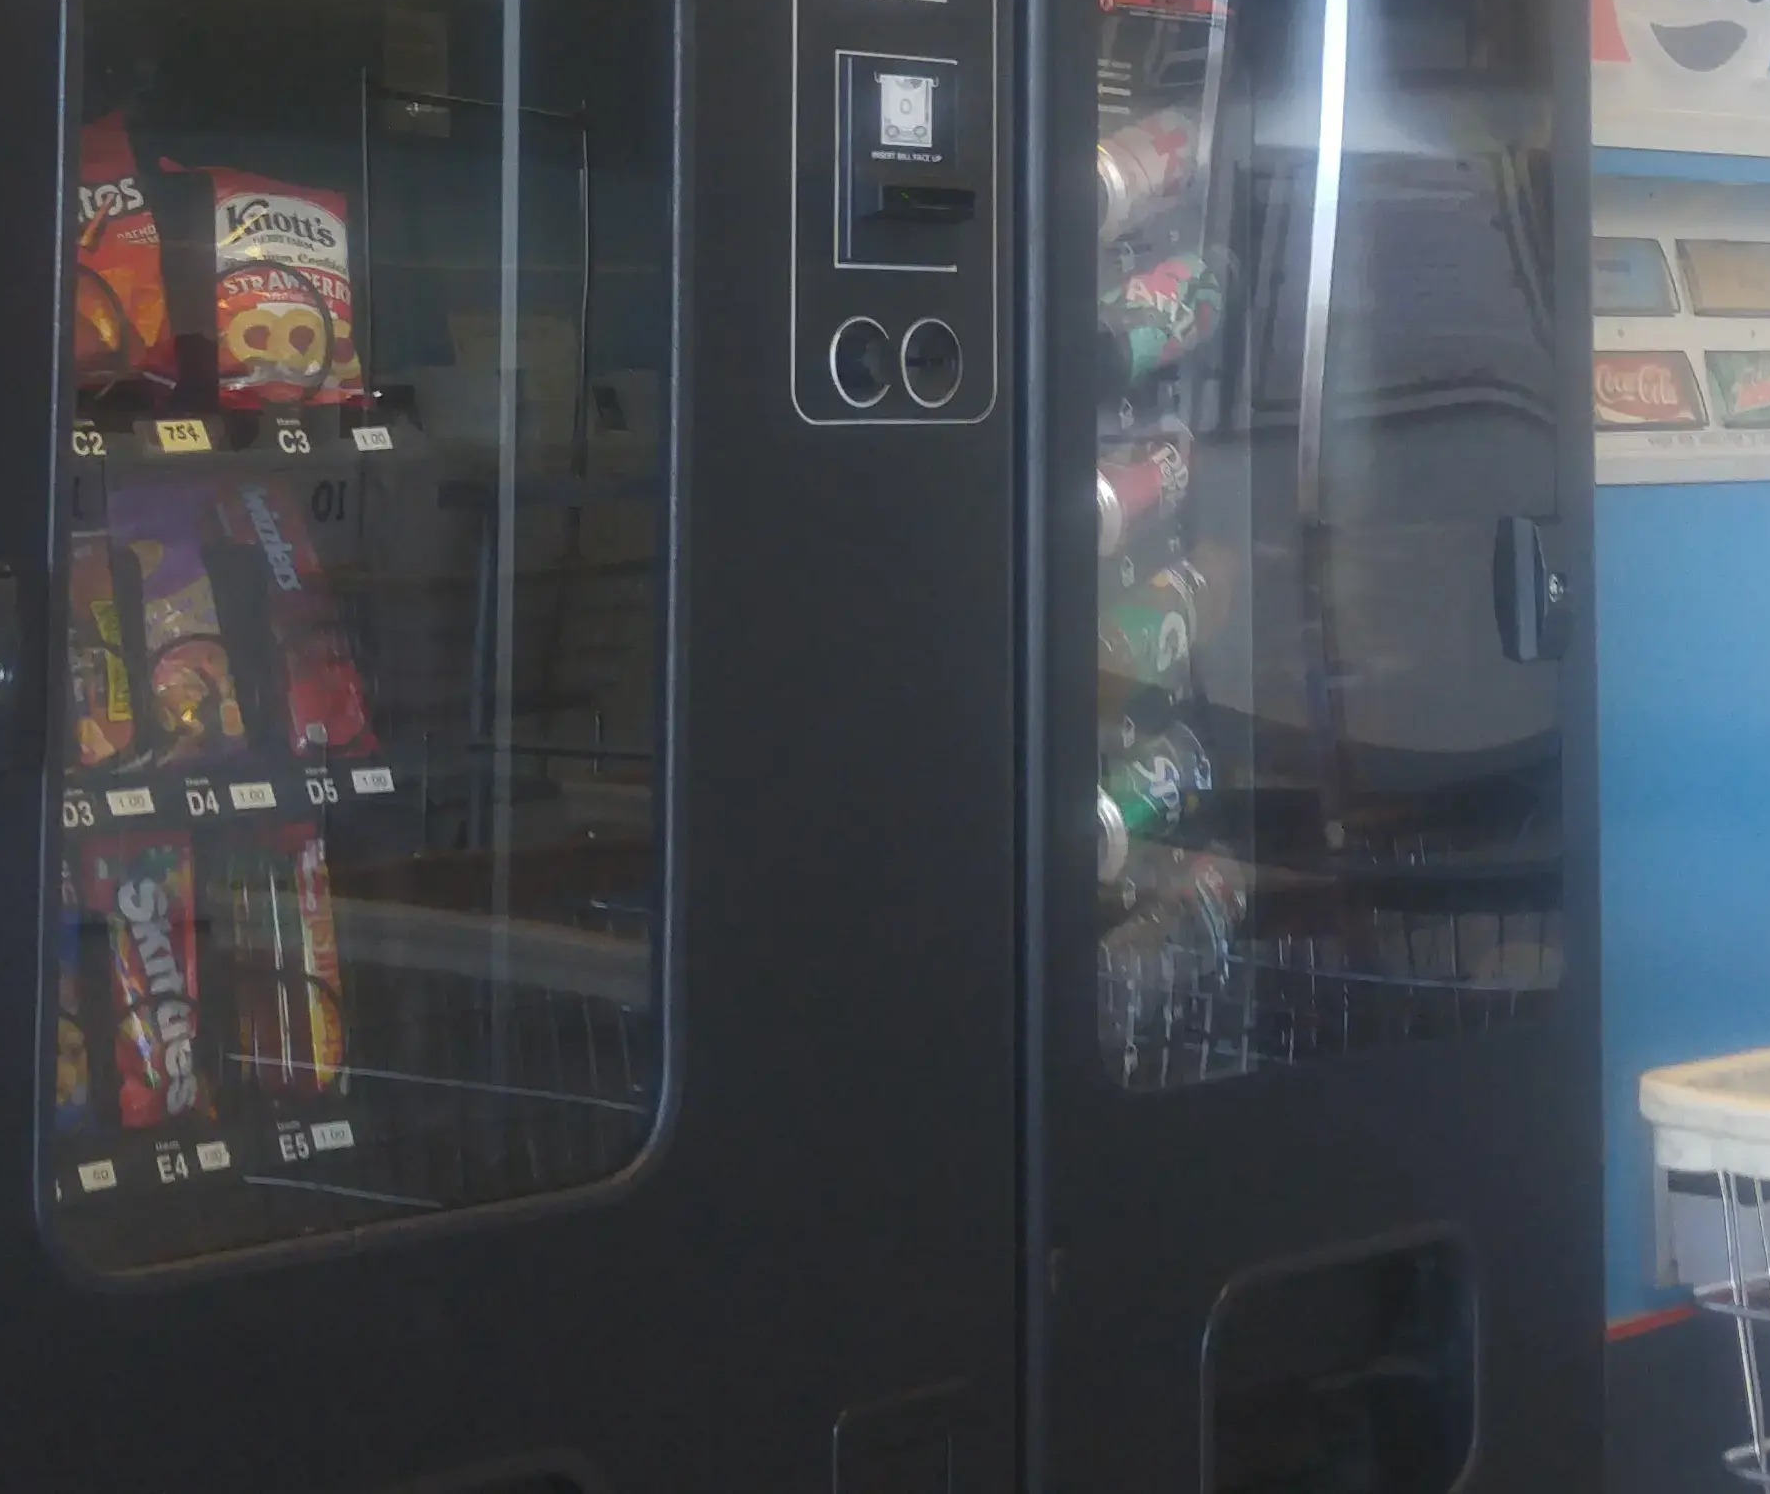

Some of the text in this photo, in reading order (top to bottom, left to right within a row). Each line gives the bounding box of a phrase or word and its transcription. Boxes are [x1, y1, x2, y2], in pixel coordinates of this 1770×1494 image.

[226, 198, 336, 249] Knott's
[72, 431, 107, 456] C2
[279, 430, 311, 455] C3
[185, 788, 220, 817] D4
[306, 777, 339, 805] D5
[62, 800, 95, 828] D3
[278, 1132, 310, 1163] E5
[156, 1151, 190, 1184] E4
